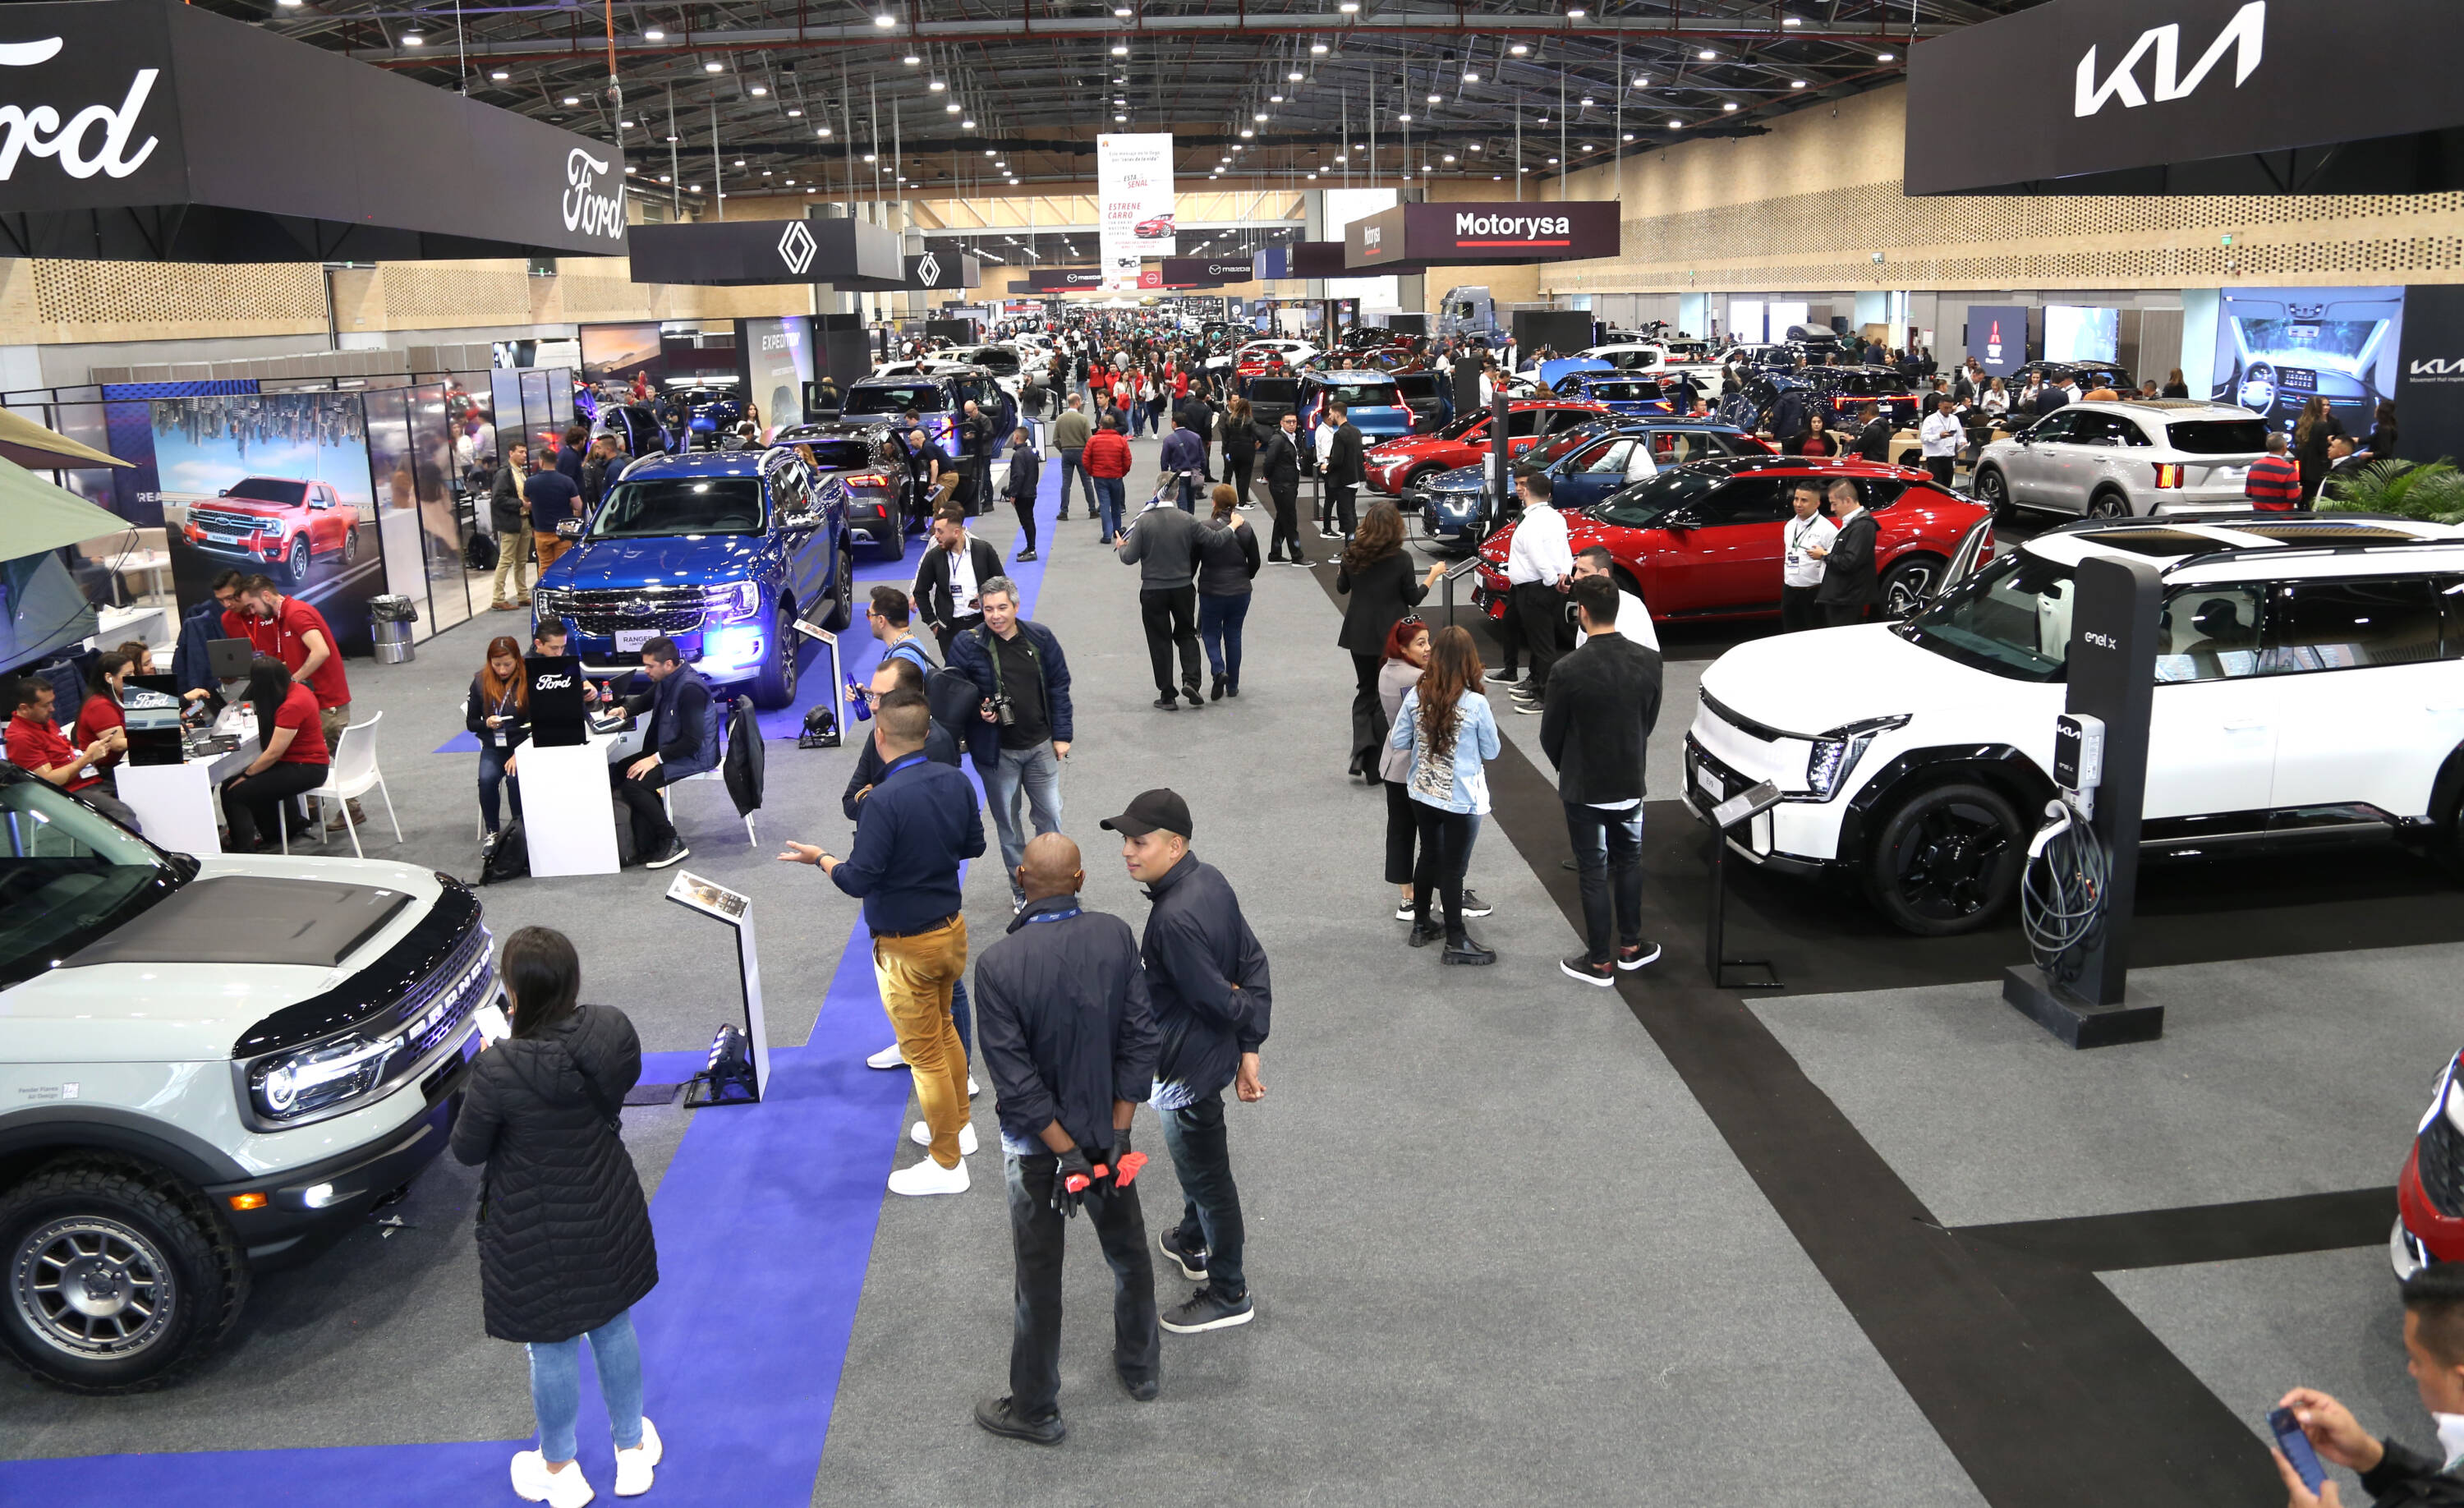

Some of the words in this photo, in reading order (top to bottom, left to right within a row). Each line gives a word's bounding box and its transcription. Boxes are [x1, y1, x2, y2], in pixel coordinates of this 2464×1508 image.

[2075, 0, 2265, 117] KIA
[563, 148, 624, 240] Ford
[1109, 202, 1141, 211] ESTRENE
[1108, 211, 1133, 220] CARRO
[1455, 212, 1570, 240] Motorysa
[762, 332, 800, 351] EXPEDITION
[2411, 358, 2464, 375] KIA
[2085, 632, 2107, 647] enel
[536, 674, 572, 691] Ford
[133, 692, 169, 709] Ford
[2057, 724, 2081, 739] KIA
[408, 937, 494, 1040] BRONCO
